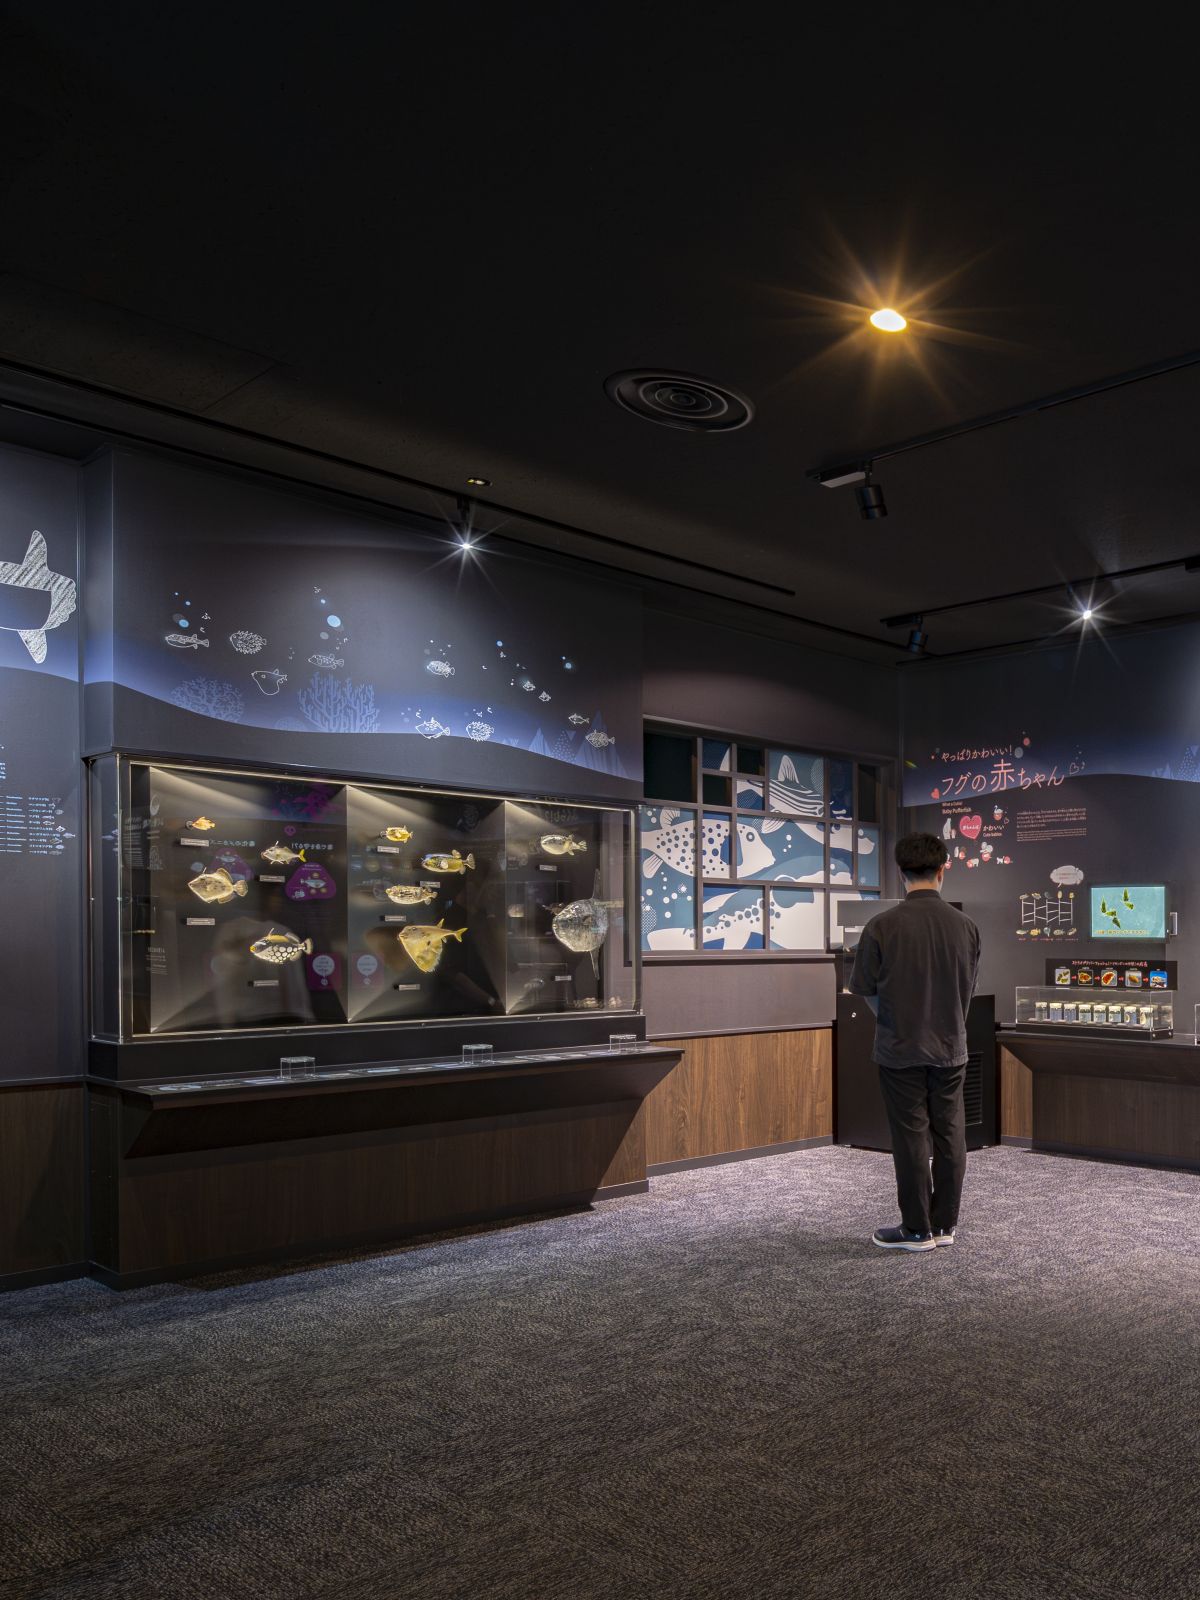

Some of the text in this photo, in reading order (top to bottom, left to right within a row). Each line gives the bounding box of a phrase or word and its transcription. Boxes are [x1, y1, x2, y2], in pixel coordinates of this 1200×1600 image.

[941, 744, 1013, 763] やっぱりかわいい!
[942, 758, 1065, 796] フグの赤ちゃん
